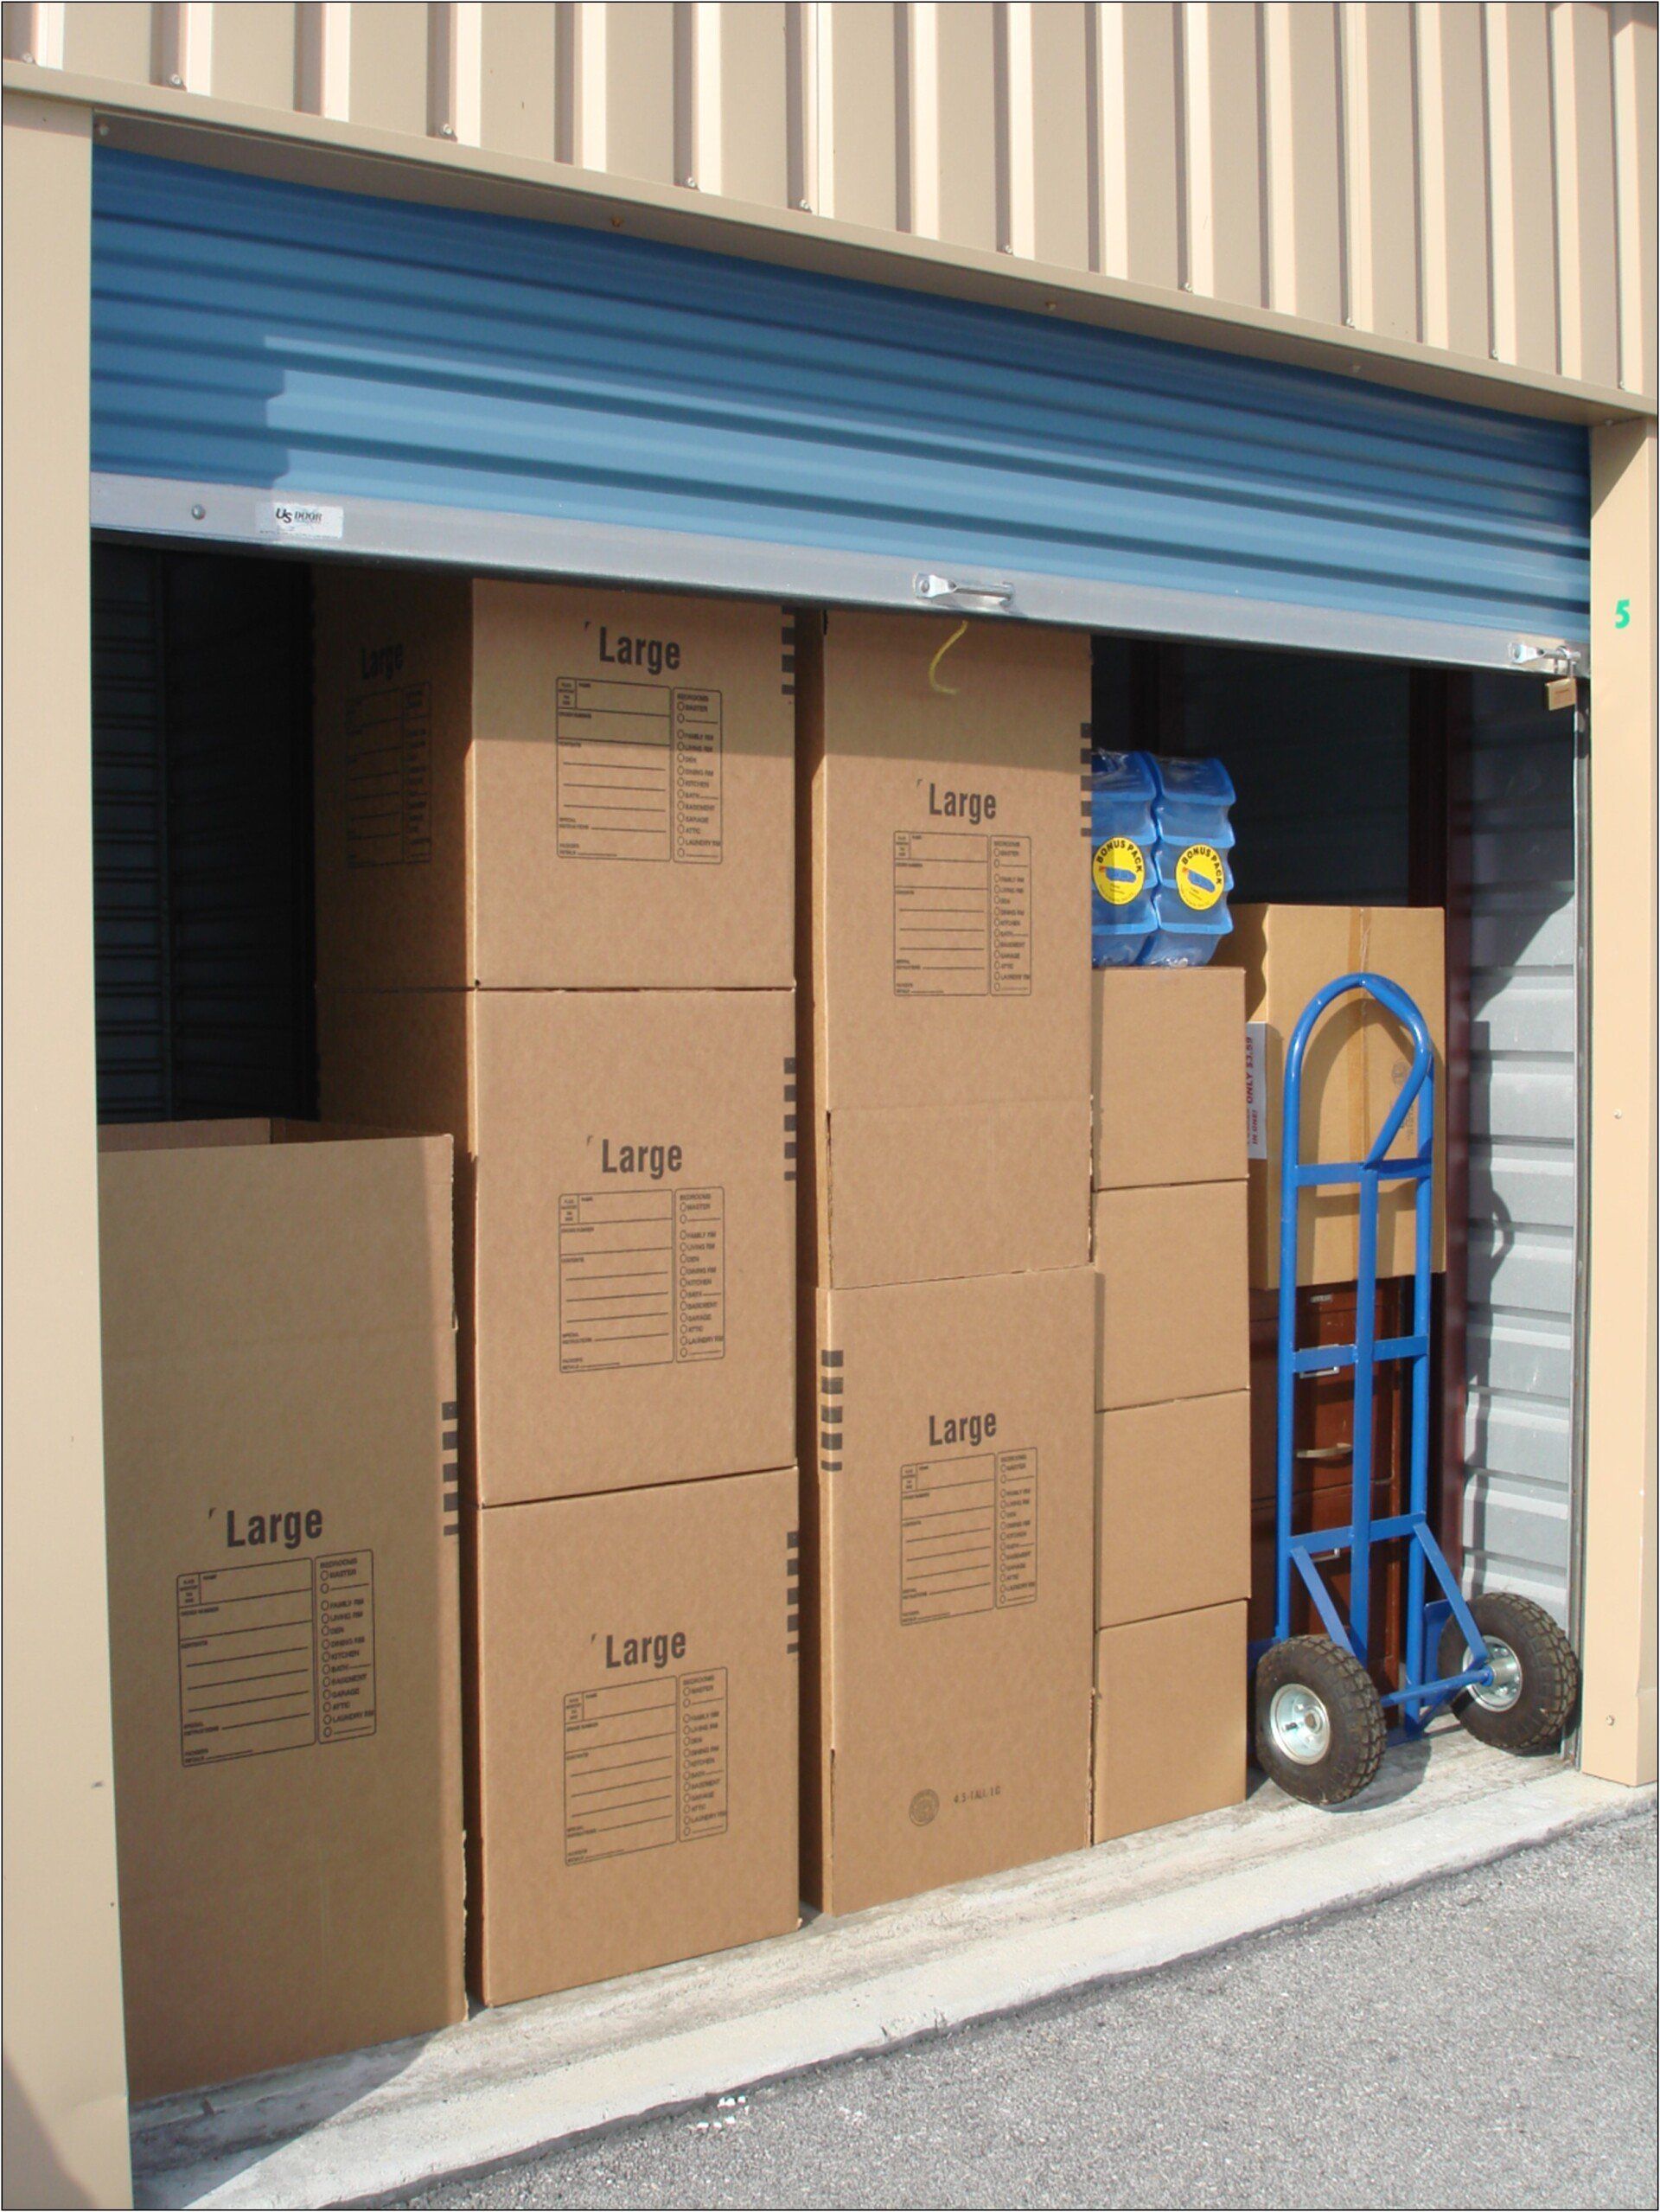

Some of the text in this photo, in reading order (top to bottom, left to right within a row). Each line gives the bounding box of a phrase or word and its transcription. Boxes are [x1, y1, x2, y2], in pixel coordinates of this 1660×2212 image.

[1614, 598, 1631, 629] 5
[599, 626, 681, 675] Large
[929, 783, 997, 825] Large
[1096, 840, 1142, 873] BONUS PACK
[1181, 847, 1223, 885] BONUS PACK
[602, 1138, 683, 1180] Large
[929, 1412, 998, 1447] Large
[227, 1508, 323, 1550] Large
[606, 1631, 686, 1669] Large
